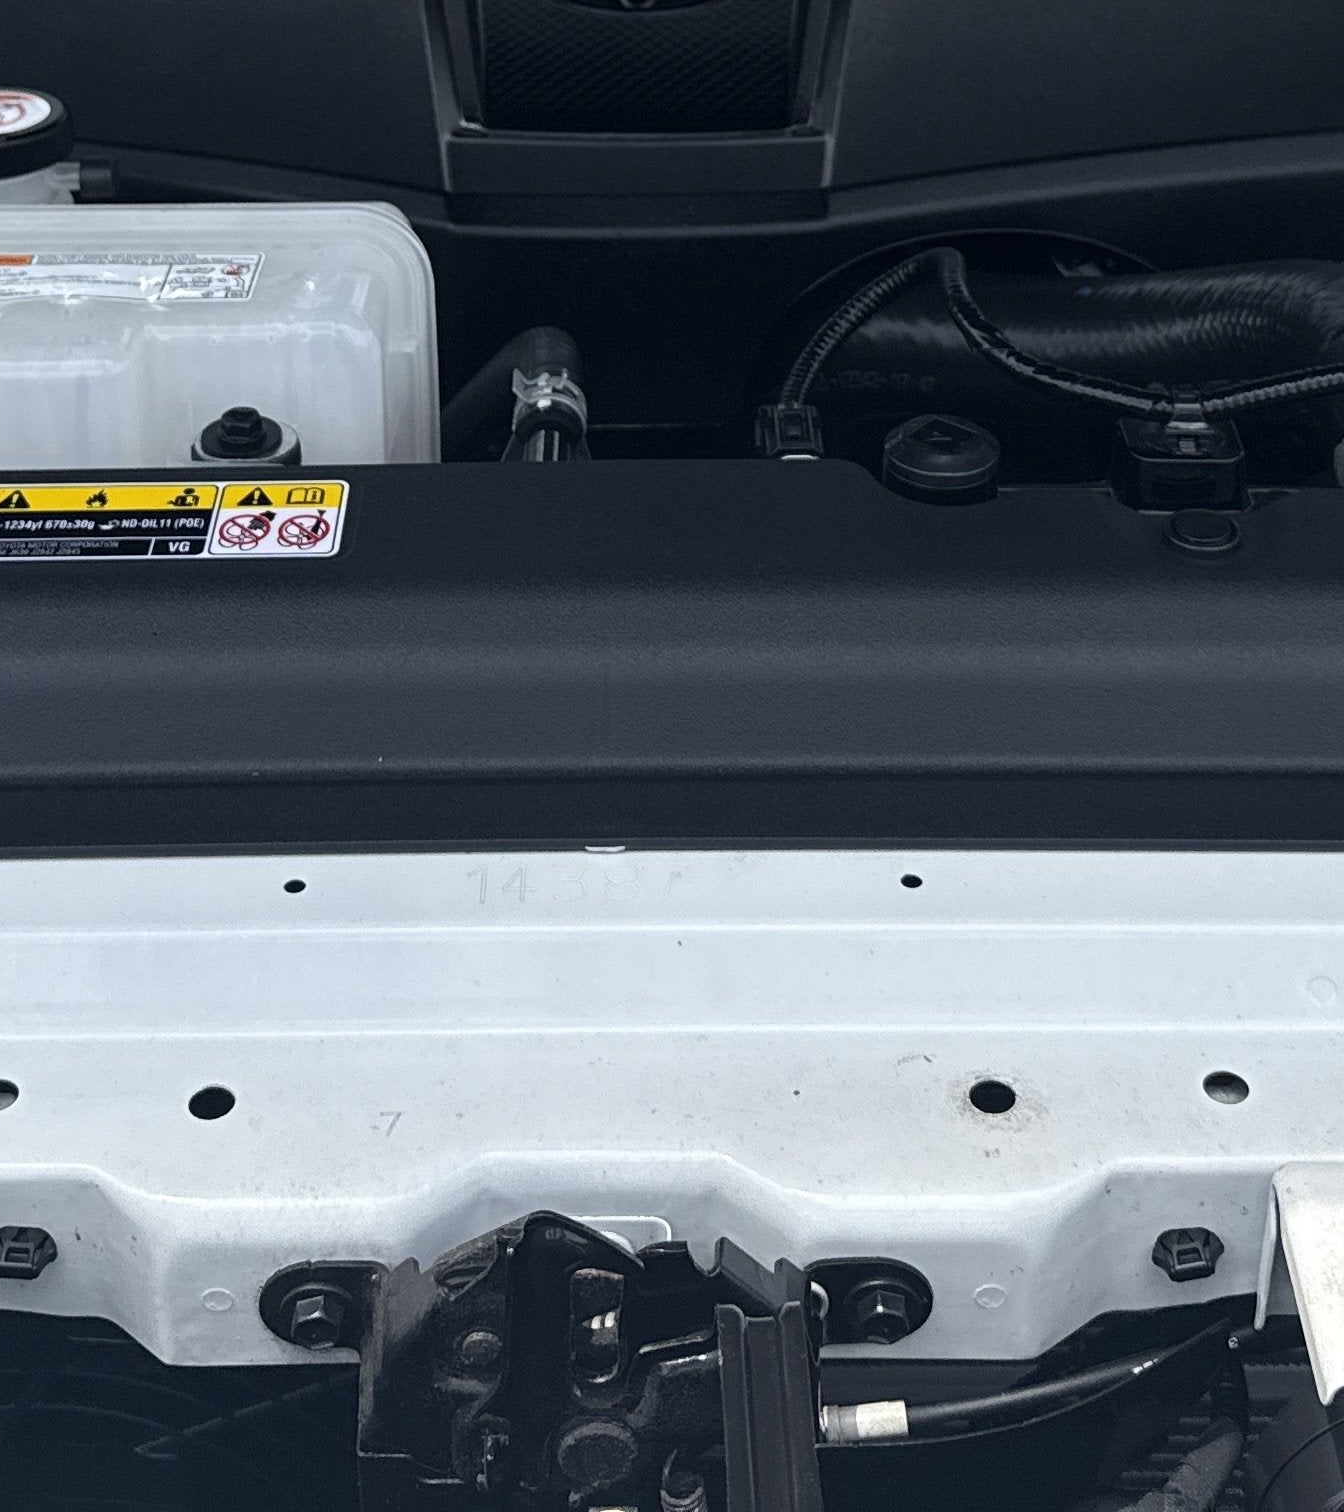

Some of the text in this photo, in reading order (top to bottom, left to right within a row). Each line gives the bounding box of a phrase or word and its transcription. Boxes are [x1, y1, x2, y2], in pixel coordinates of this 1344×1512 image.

[121, 518, 158, 529] ND-OIL
[174, 517, 205, 529] (POE)
[168, 541, 191, 553] VG
